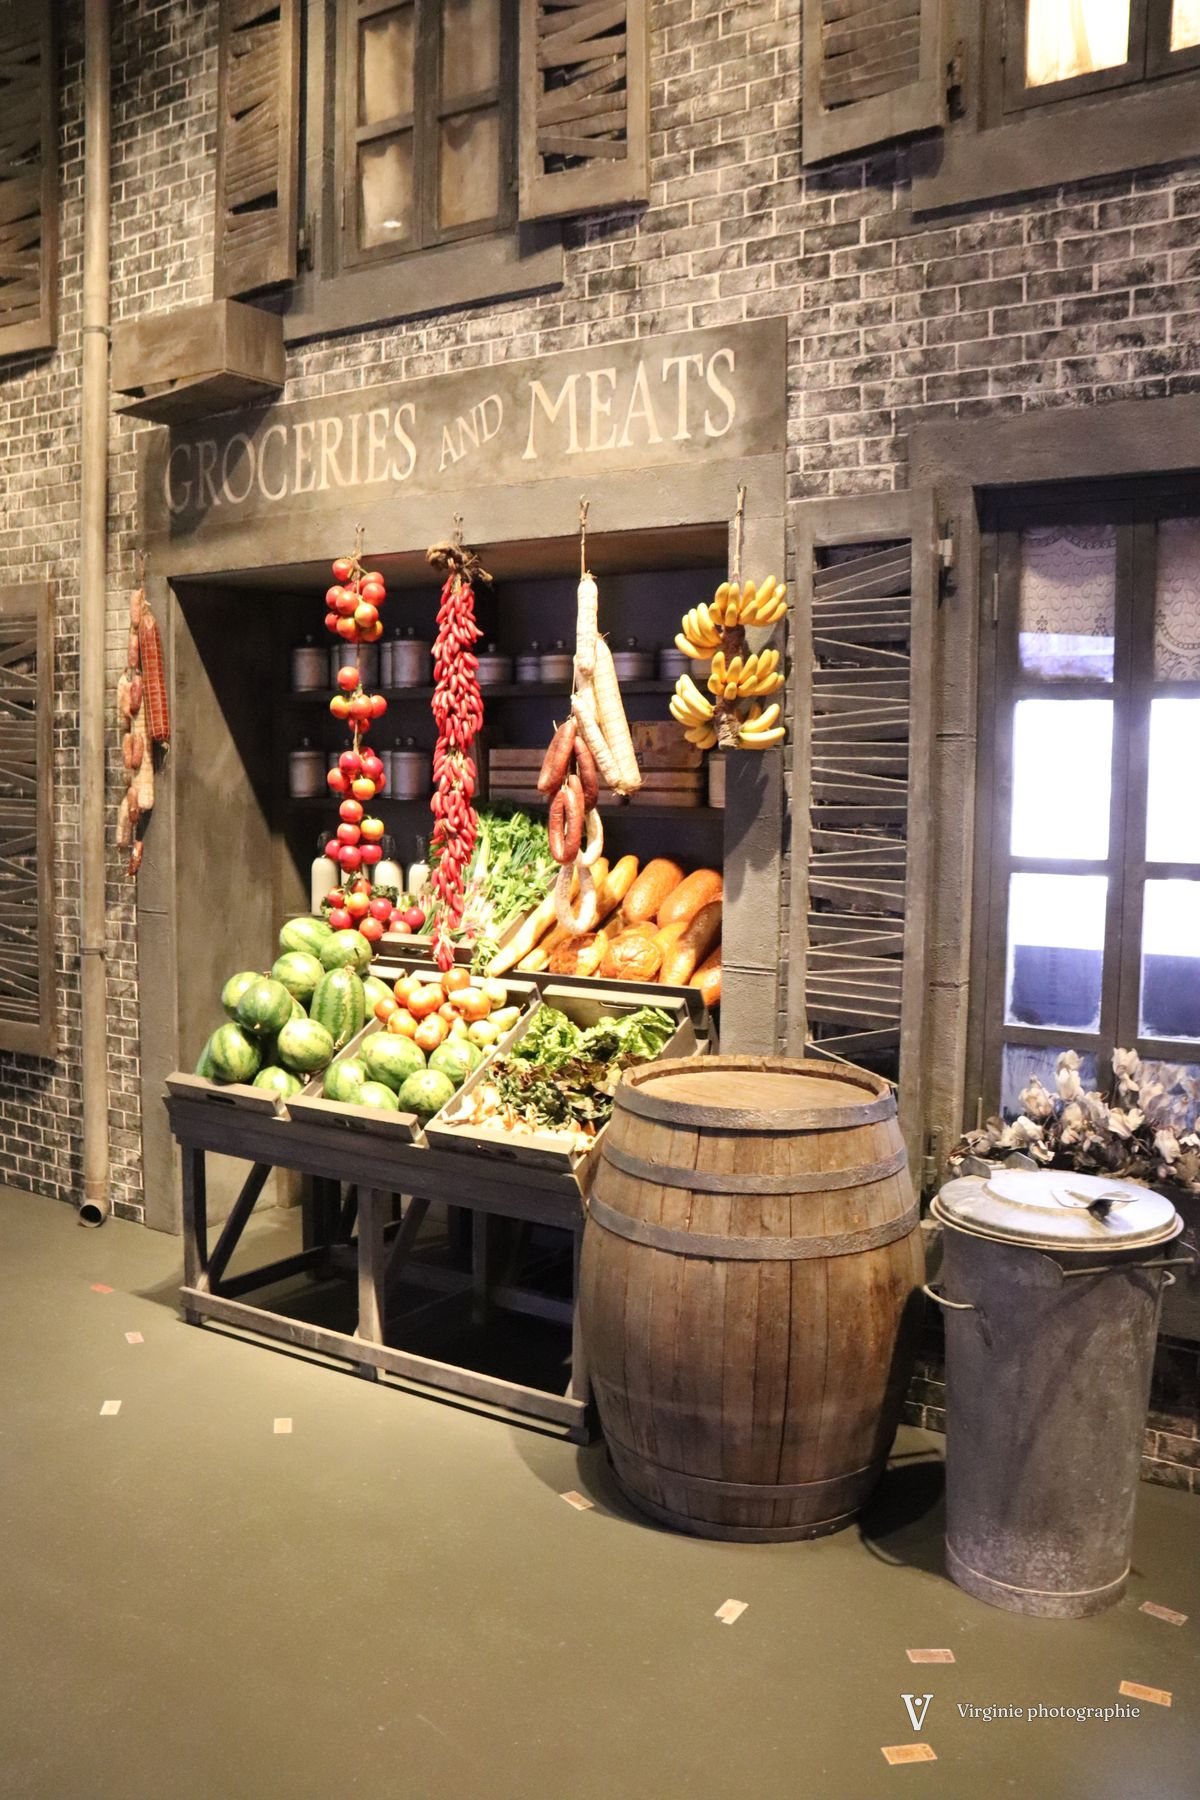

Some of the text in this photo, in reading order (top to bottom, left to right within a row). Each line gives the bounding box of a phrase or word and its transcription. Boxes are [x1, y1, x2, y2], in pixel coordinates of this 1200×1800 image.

[163, 347, 736, 514] GROCERIES AND MEATS
